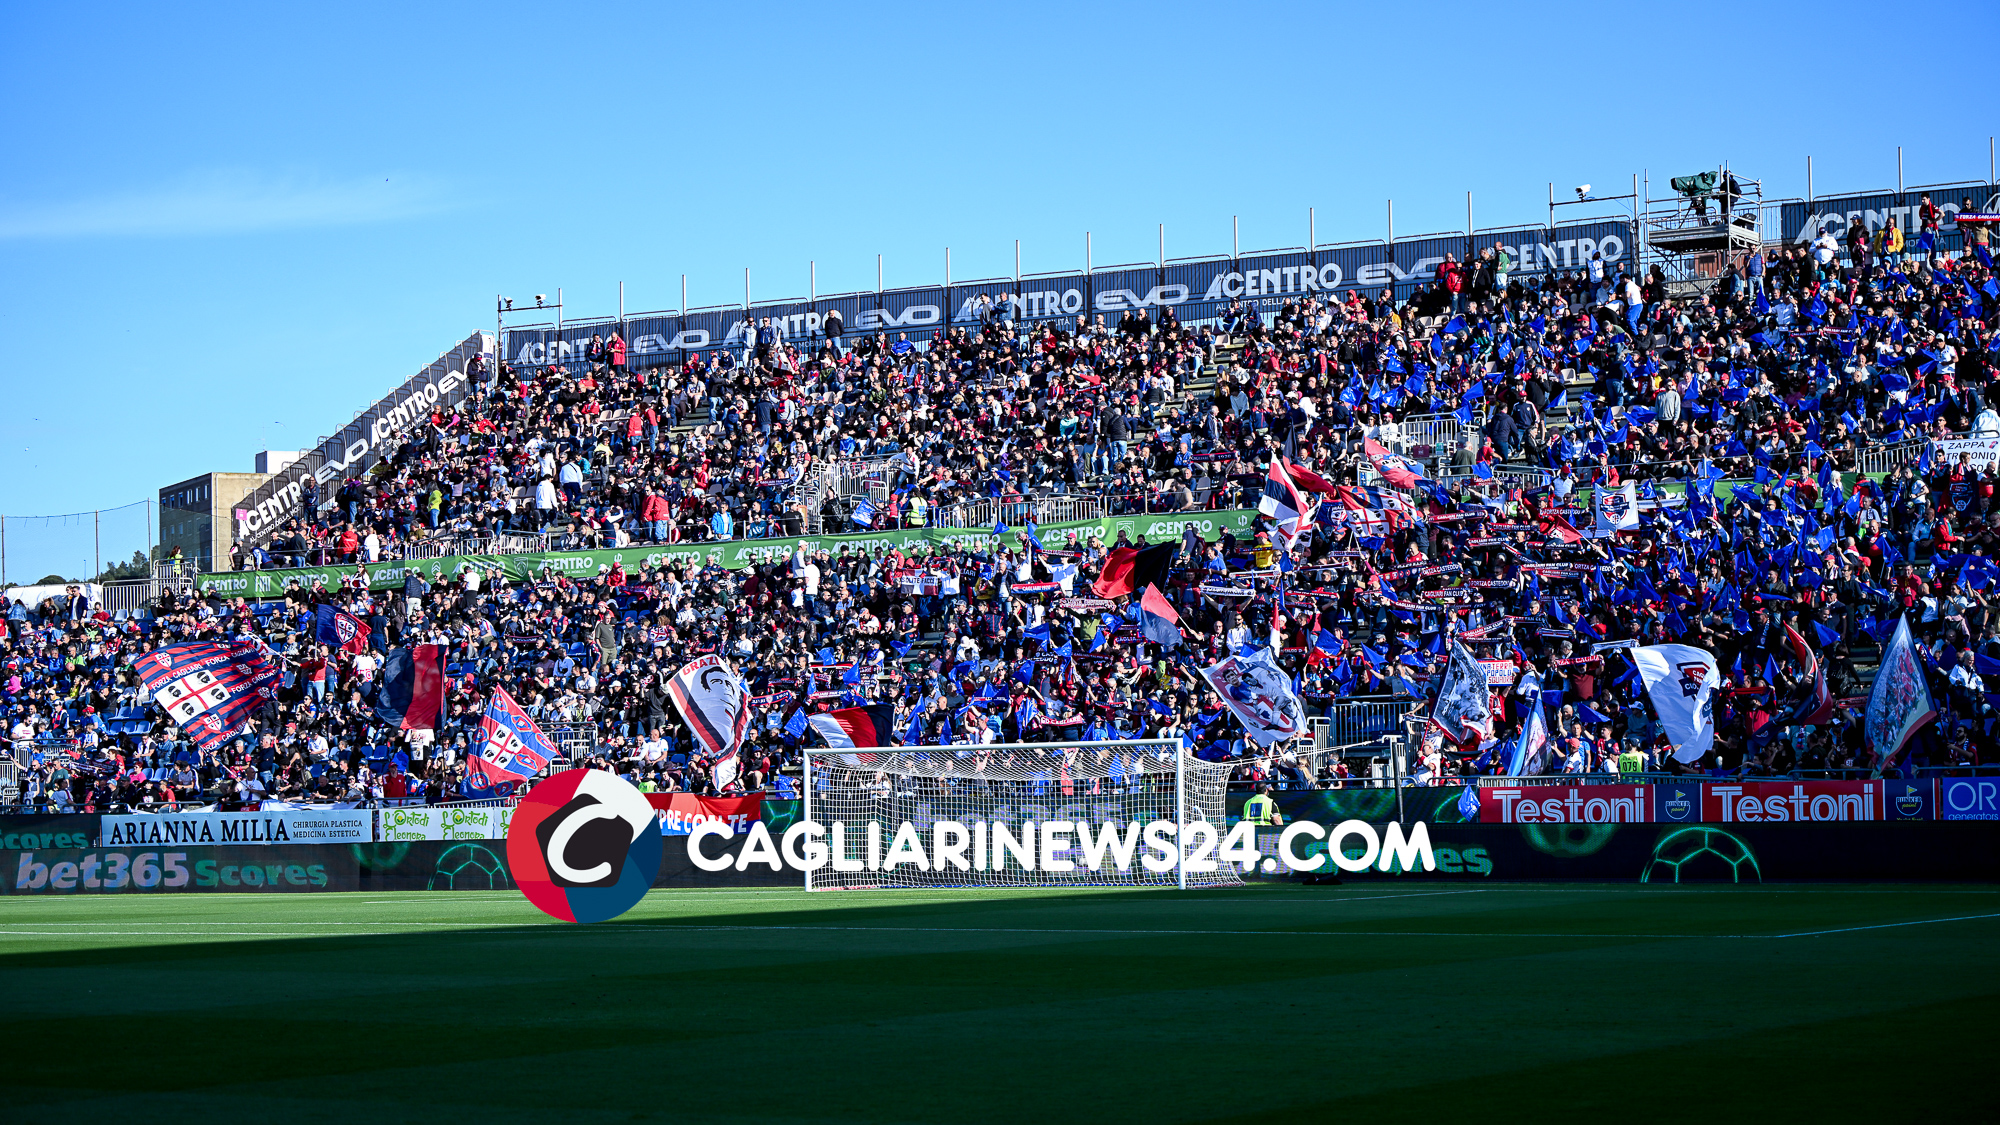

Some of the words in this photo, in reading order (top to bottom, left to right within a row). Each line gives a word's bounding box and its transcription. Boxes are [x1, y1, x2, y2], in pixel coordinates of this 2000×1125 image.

[1794, 201, 1961, 245] ACNTO
[1203, 263, 1343, 302] ACENTRO
[953, 288, 1083, 323] ANTRO
[1095, 283, 1189, 311] EVO
[855, 304, 940, 331] EVO
[514, 337, 592, 366] ACENT
[633, 328, 710, 354] EVO
[438, 356, 470, 395] EV
[371, 383, 438, 449] ACENTRO
[1946, 451, 1997, 461] TRONIO
[1947, 440, 1986, 450] ZAPPA
[315, 438, 369, 485] EVO
[1145, 518, 1213, 541] ACENRO
[372, 566, 421, 582] ACENTO
[151, 675, 172, 691] FORZA
[172, 662, 203, 679] CAGLIARI
[205, 654, 231, 667] FORZA
[231, 681, 252, 694] FORZA
[221, 721, 248, 742] CAGLIAR
[1622, 761, 1638, 772] 079
[1492, 787, 1645, 823] Testoni
[1711, 783, 1874, 821] Testoni
[1948, 782, 1997, 812] OR
[110, 819, 214, 845] ARIANNA
[221, 818, 290, 843] MILIA
[293, 820, 329, 830] CHIRURGIA
[330, 819, 363, 829] PLASTICA
[293, 830, 327, 839] MEDICINA
[329, 828, 361, 838] ESTETICA
[728, 813, 748, 833] TE
[16, 852, 190, 890] bet365
[195, 859, 328, 889] Scores
